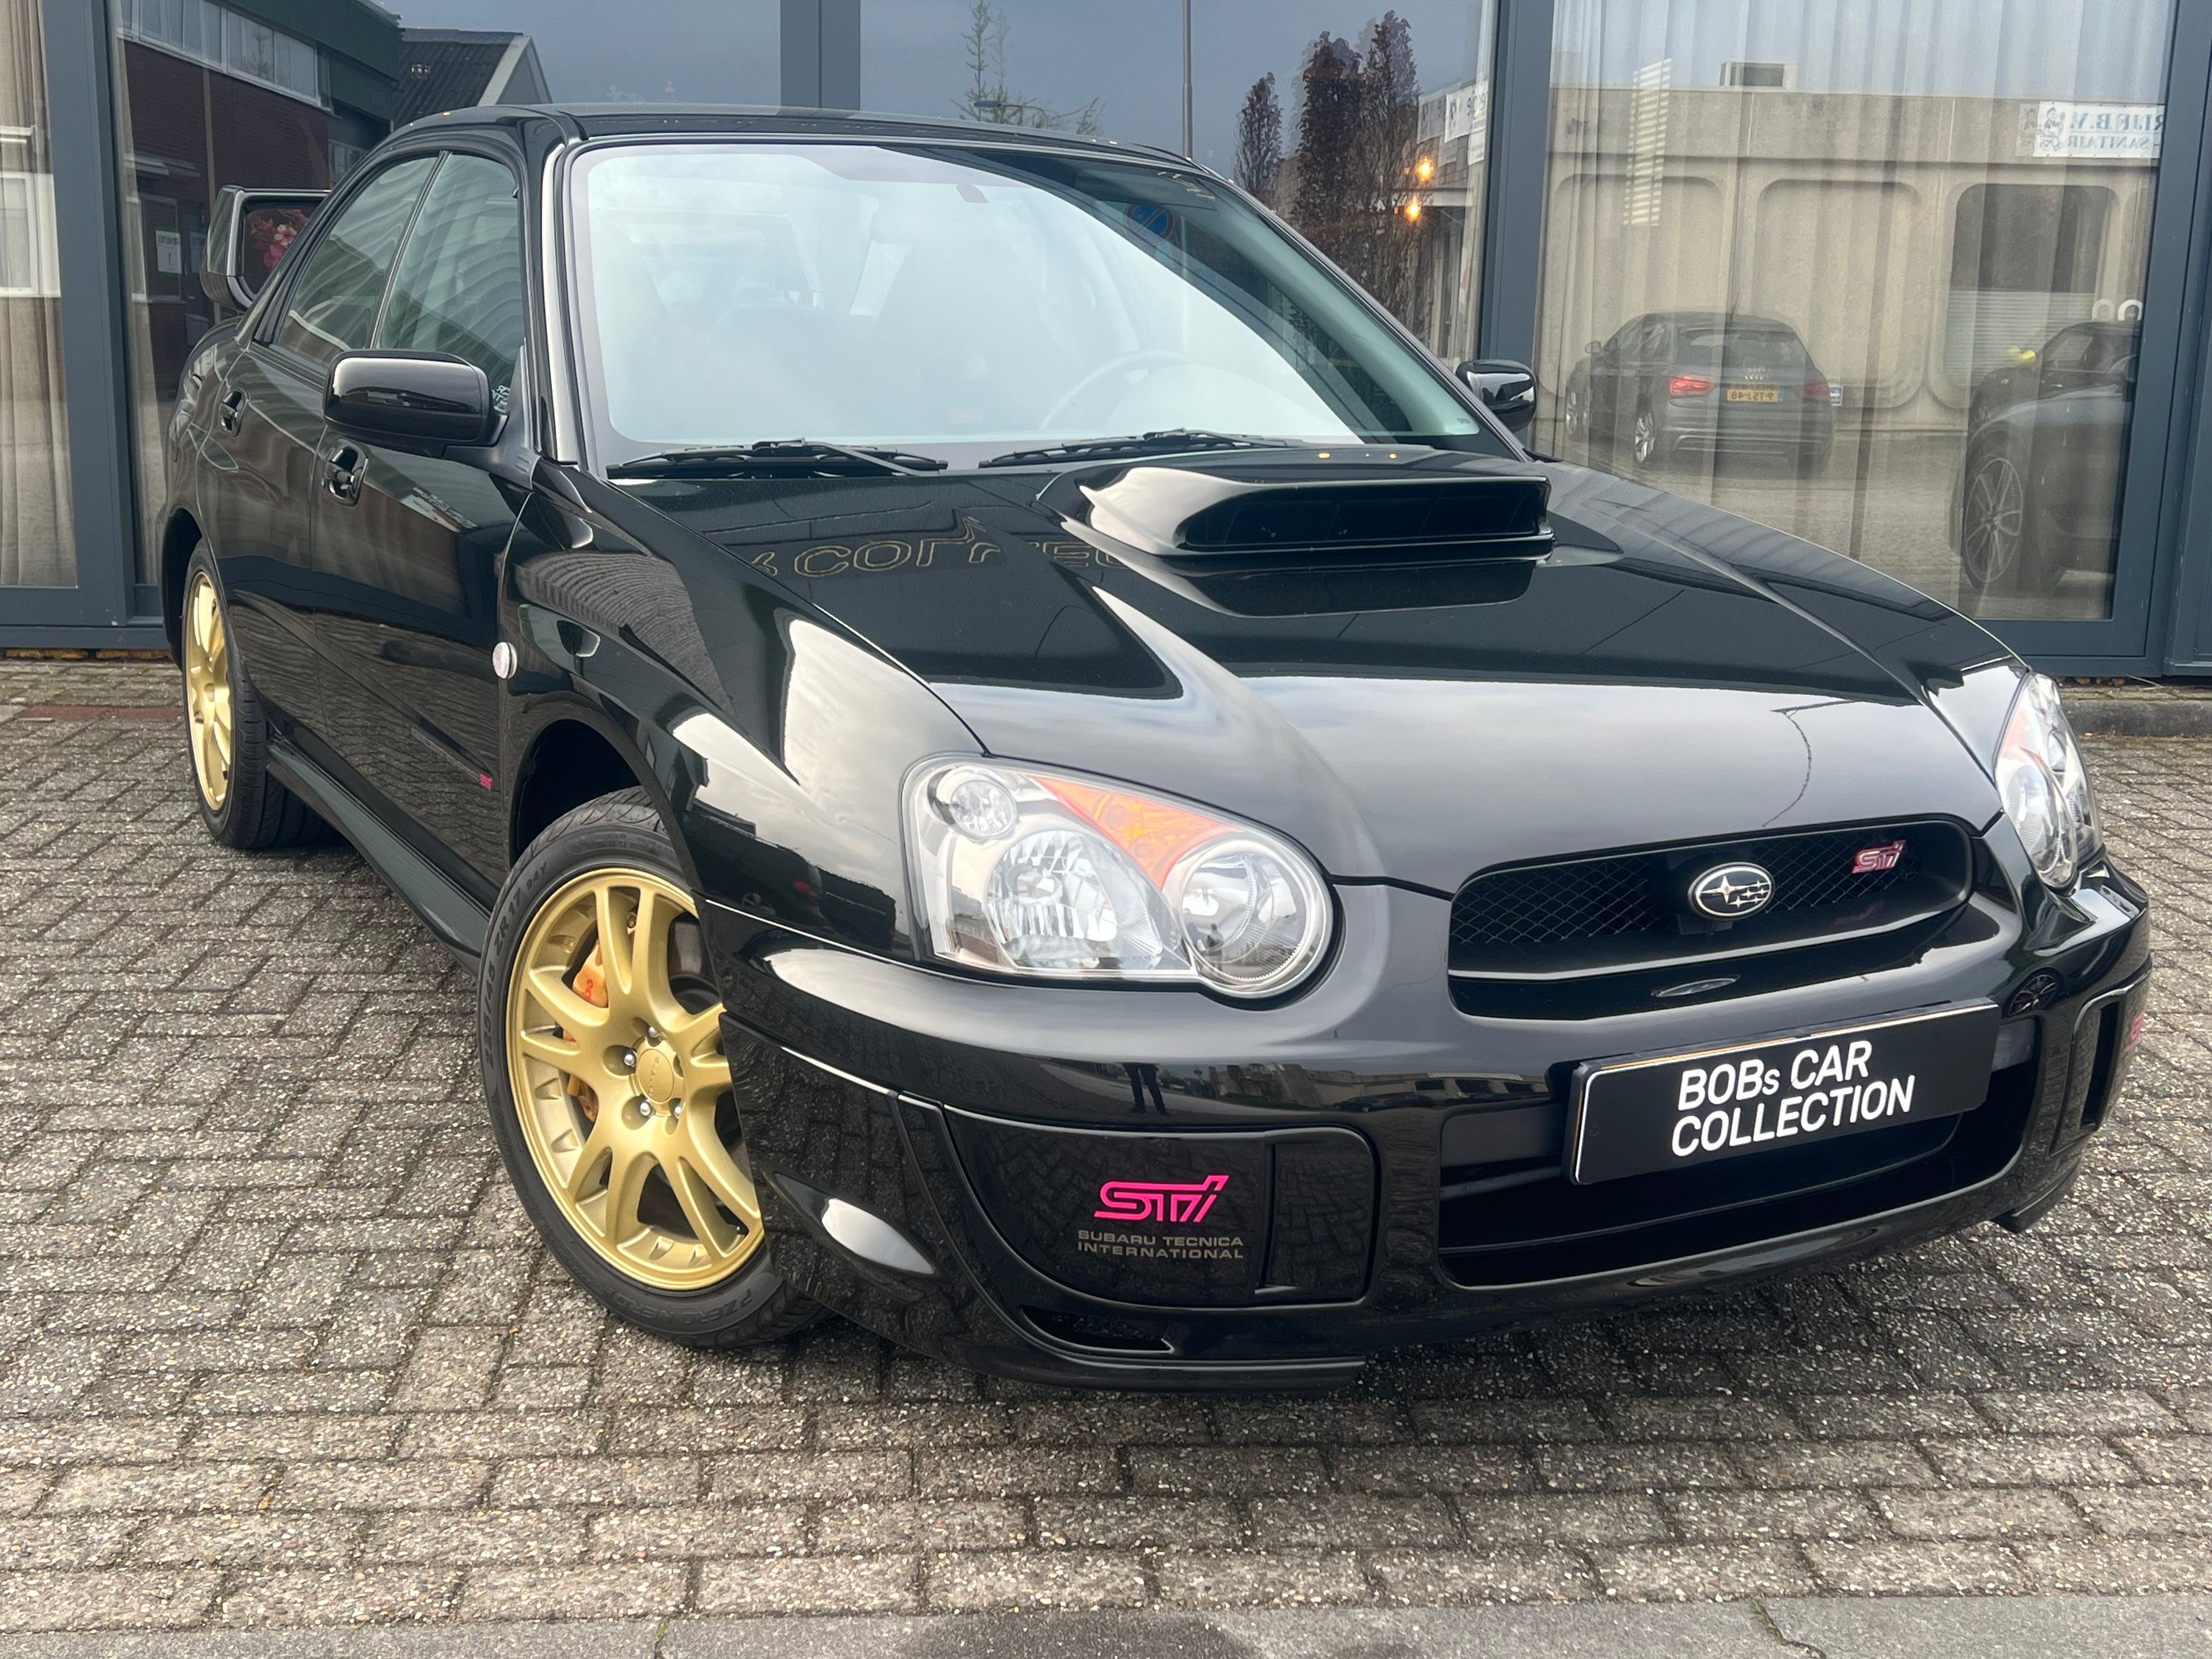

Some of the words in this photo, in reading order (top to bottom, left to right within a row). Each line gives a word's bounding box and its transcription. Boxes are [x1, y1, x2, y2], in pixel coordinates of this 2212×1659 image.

[483, 961, 496, 1070] 225/45
[1677, 1059, 1781, 1111] BOBs
[1790, 1040, 1873, 1090] CAR
[1671, 1075, 1916, 1157] COLLECTION
[1077, 1230, 1156, 1245] SUBARU
[1162, 1236, 1244, 1247] TECNICA
[1077, 1242, 1244, 1259] INTERNATIONAL
